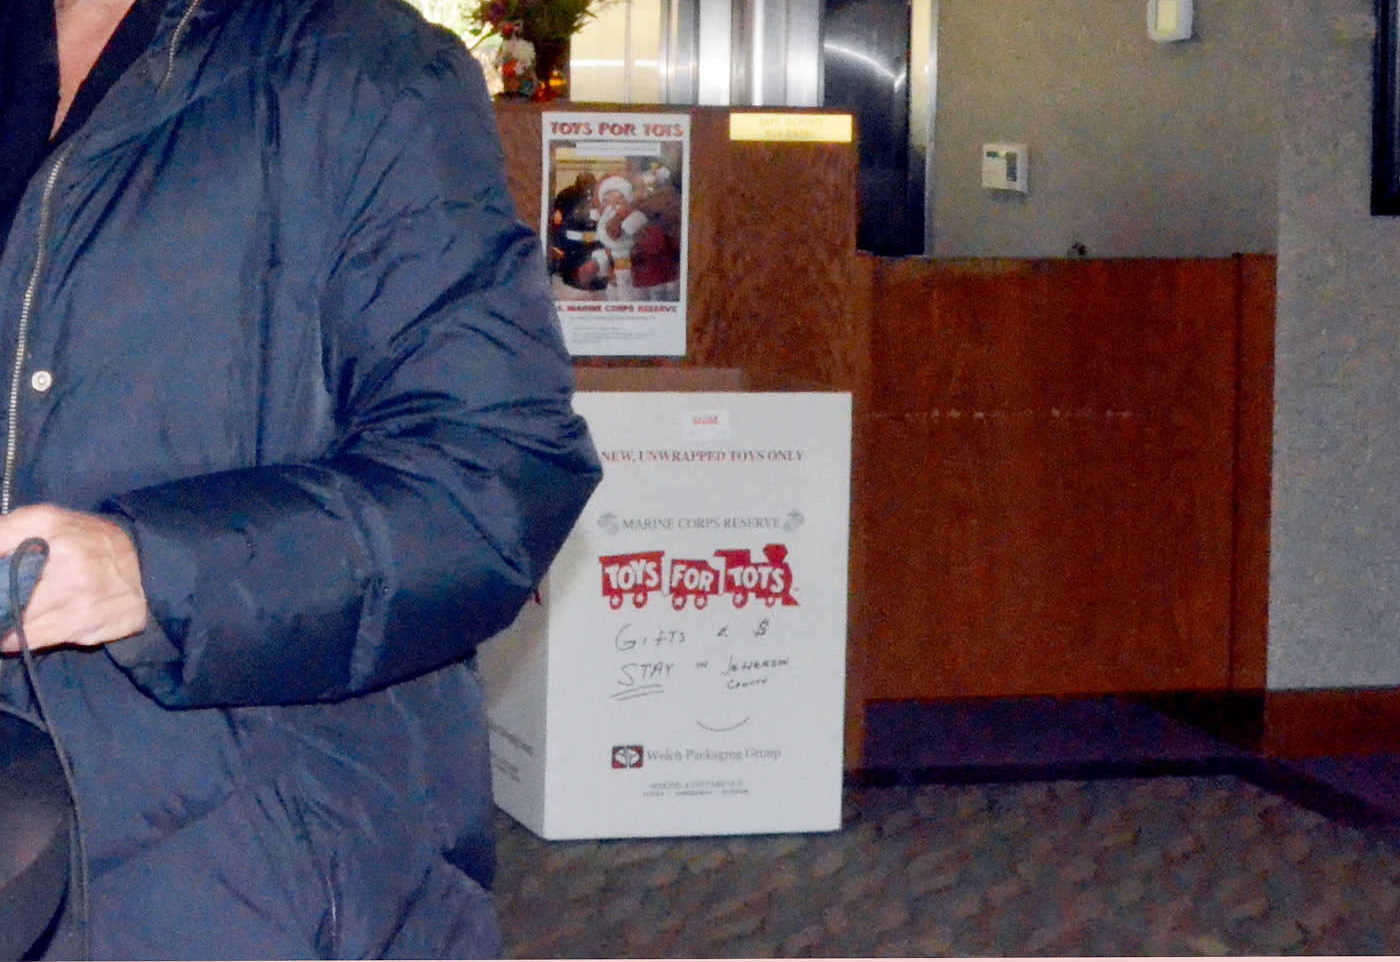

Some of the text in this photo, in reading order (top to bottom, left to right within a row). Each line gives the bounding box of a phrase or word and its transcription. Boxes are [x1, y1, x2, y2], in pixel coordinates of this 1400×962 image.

[598, 122, 637, 136] FOR
[639, 450, 726, 462] UNWRAPPED
[729, 450, 765, 462] TOYS
[767, 449, 805, 462] ONLY
[622, 516, 780, 530] MARINE CORPS RESERVE
[605, 558, 785, 594] TOYS FOR TOTS
[617, 662, 675, 686] STAY
[647, 747, 782, 762] Welch Packaging Group
